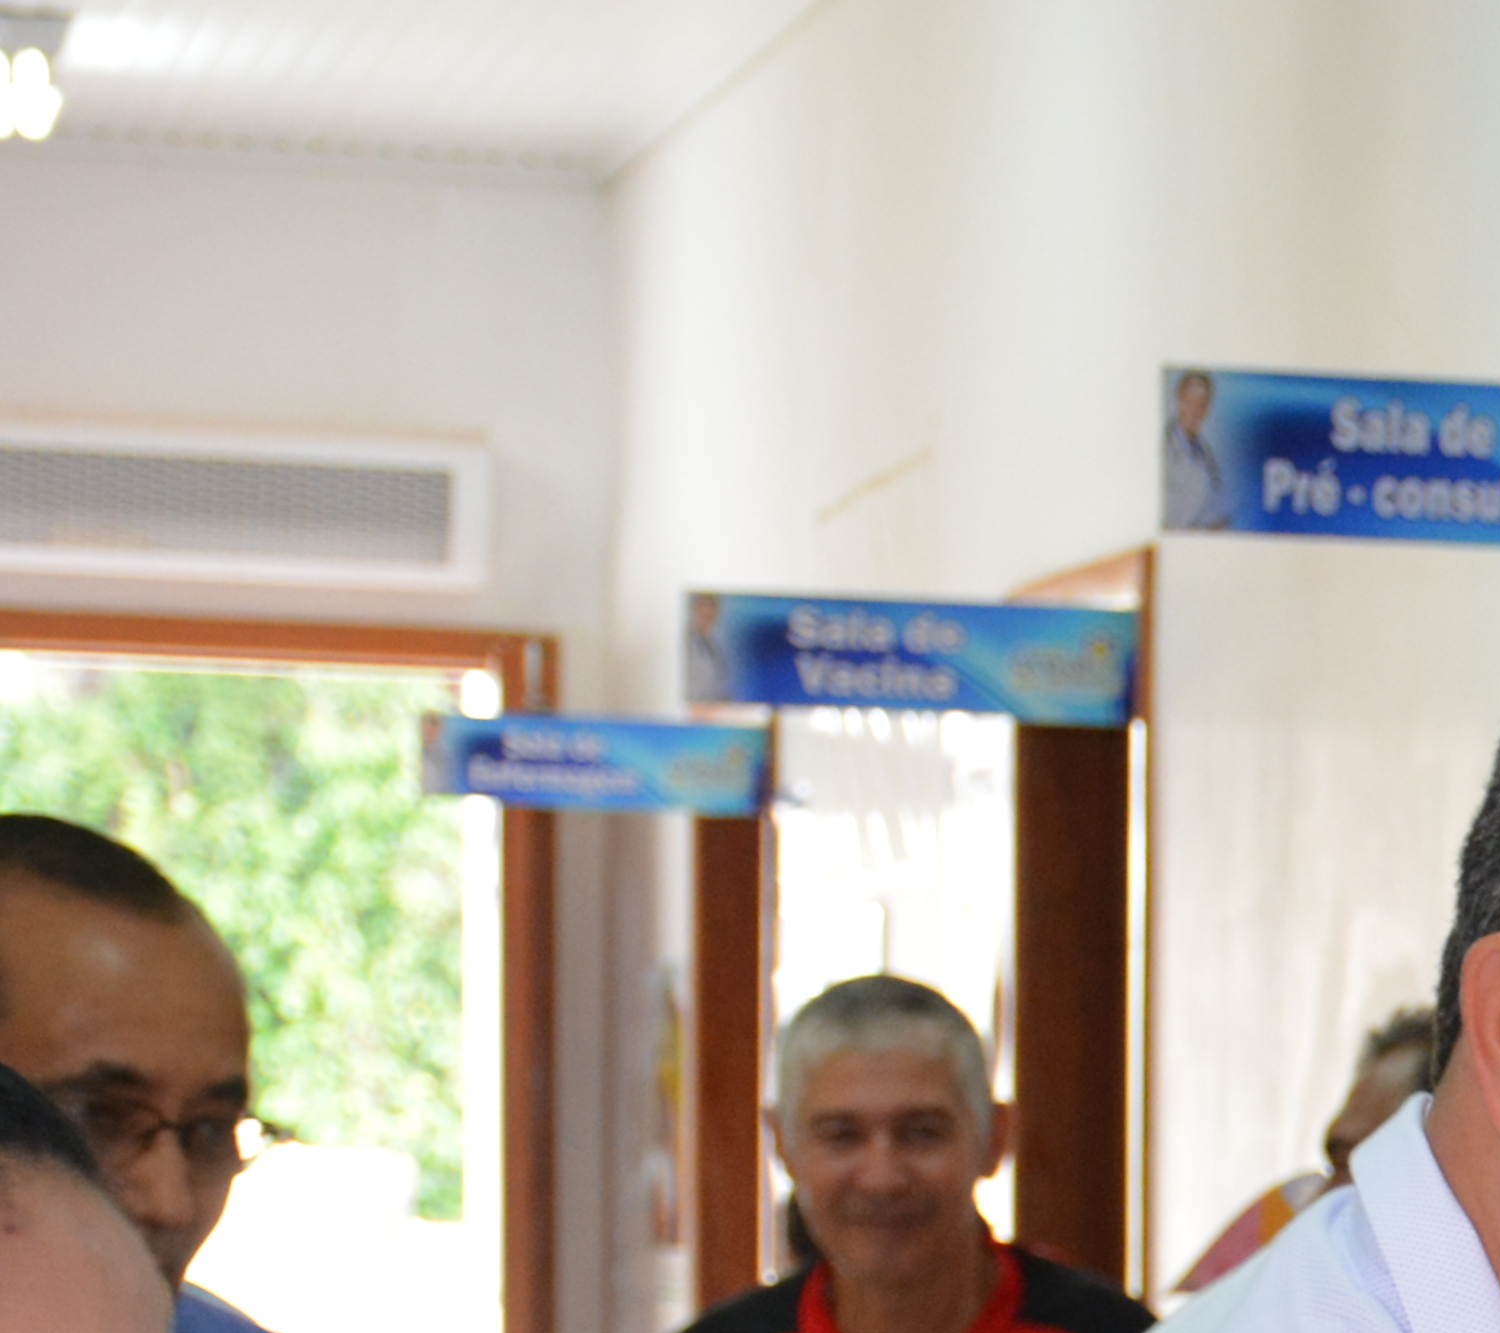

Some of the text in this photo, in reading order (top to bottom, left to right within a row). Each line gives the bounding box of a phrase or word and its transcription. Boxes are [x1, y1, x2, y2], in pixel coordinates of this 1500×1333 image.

[1330, 397, 1496, 460] Sala de
[1263, 457, 1341, 517] Pré
[787, 604, 894, 651] Sala
